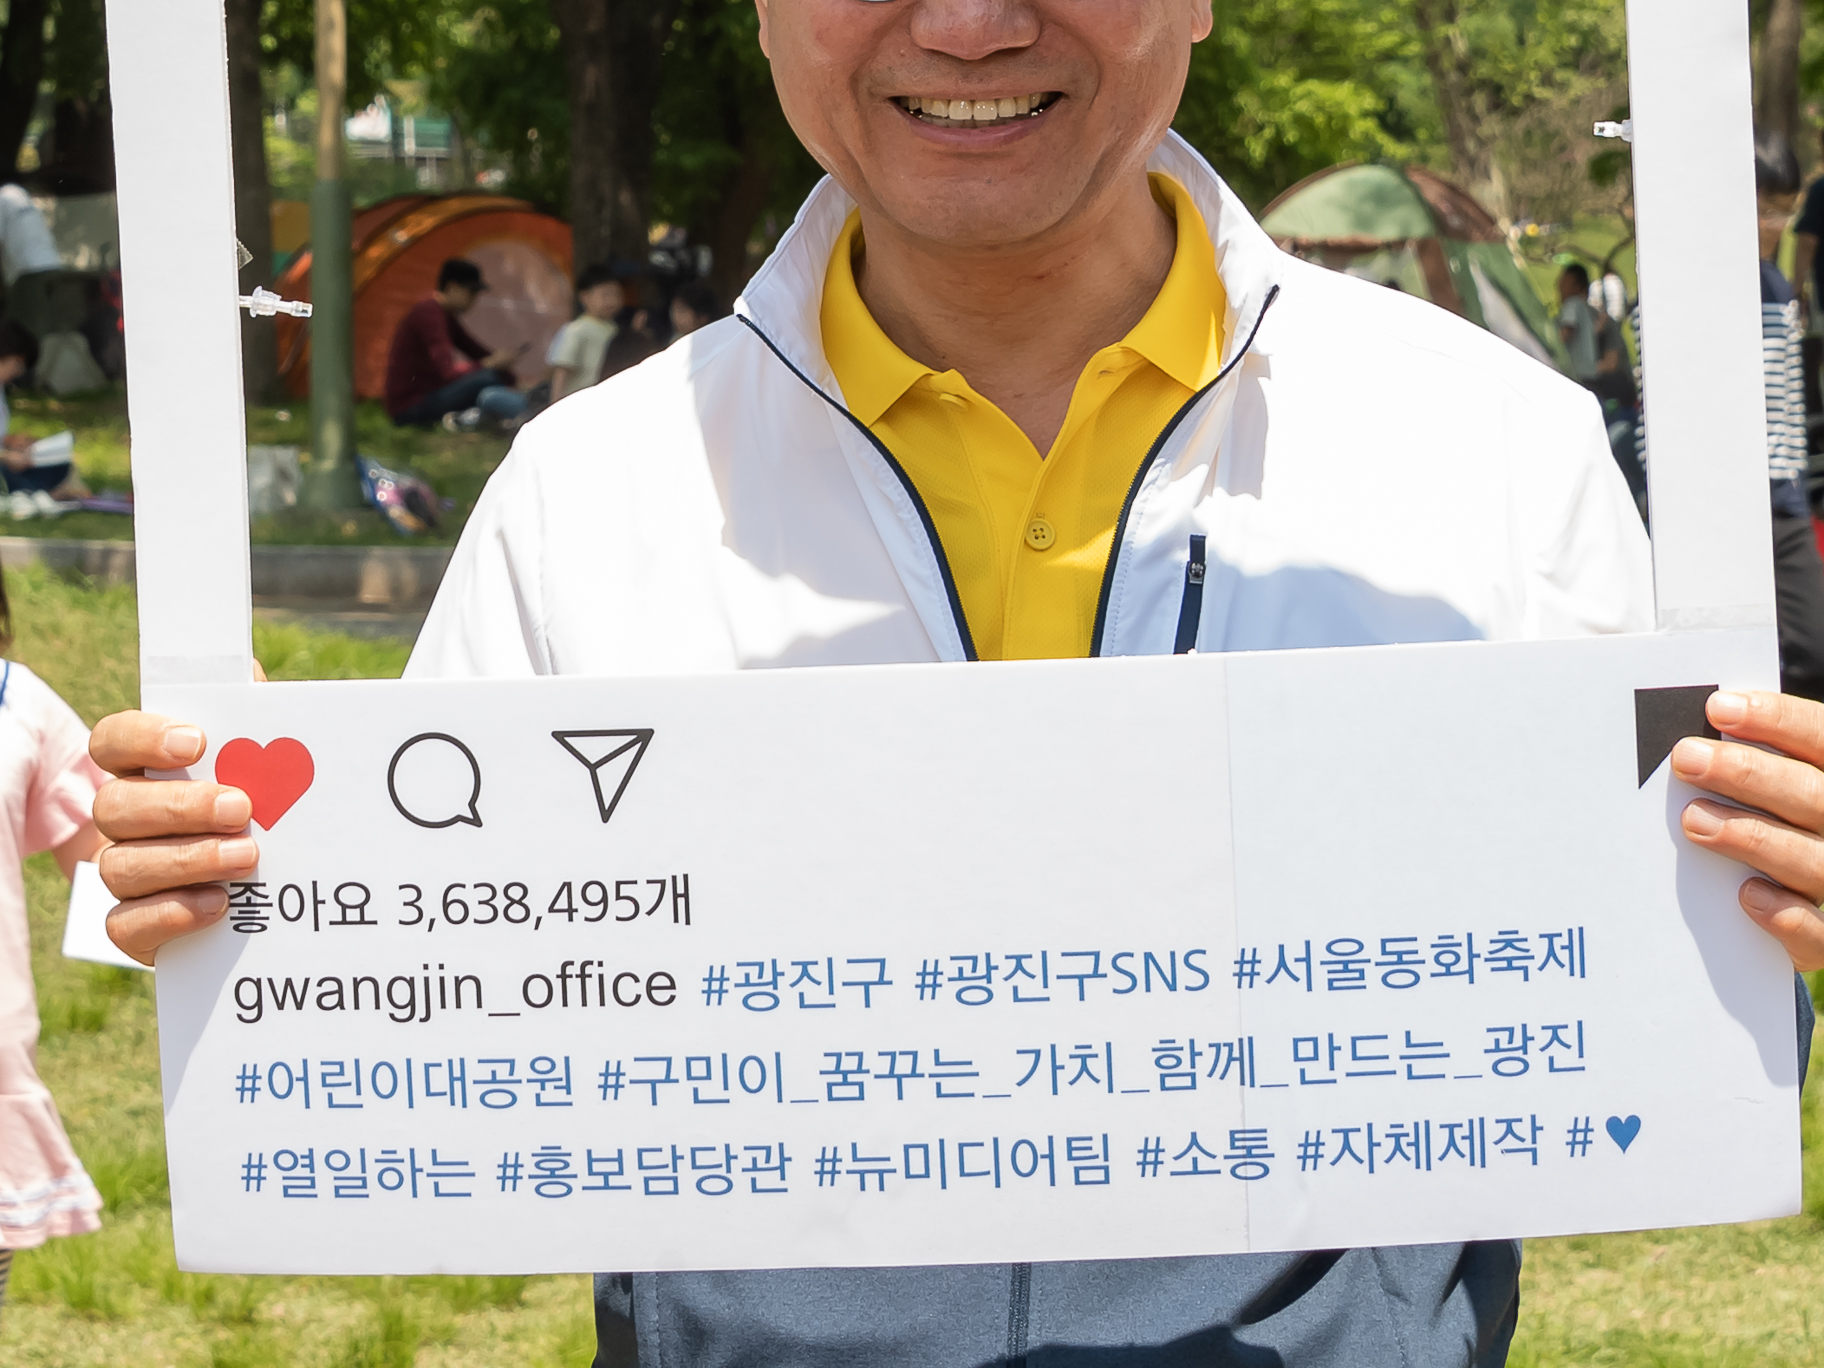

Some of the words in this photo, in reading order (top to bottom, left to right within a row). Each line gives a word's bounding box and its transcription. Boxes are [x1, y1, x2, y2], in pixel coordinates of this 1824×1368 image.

[229, 880, 378, 933] 좋아요
[399, 874, 690, 932] 3,638,495개
[235, 960, 676, 1023] gwangjin_office
[702, 957, 893, 1011] #광진구
[915, 949, 1209, 1006] #광진구SNS
[1233, 927, 1585, 992] #서울동화축제
[236, 1056, 573, 1109] #어린이대공원
[598, 1020, 1585, 1106] #구민이_꿈꾸는_가치_함께_만드는_광진
[241, 1148, 475, 1198] #열일하는
[497, 1142, 792, 1198] #홍보담당관
[814, 1133, 1110, 1191] #뉴미디어팀
[1137, 1129, 1275, 1180] #소통
[1297, 1114, 1543, 1174] #자체제작
